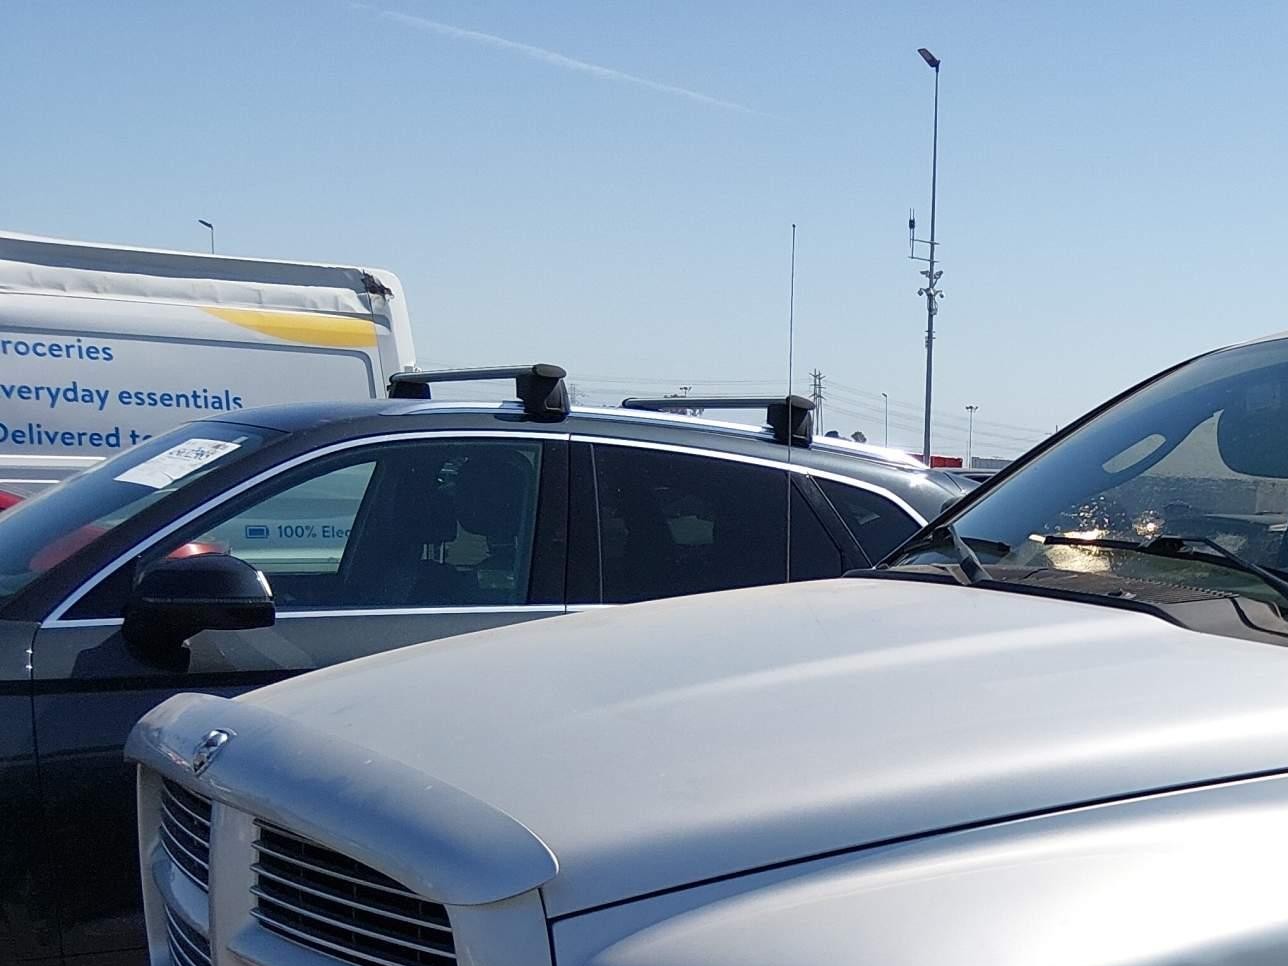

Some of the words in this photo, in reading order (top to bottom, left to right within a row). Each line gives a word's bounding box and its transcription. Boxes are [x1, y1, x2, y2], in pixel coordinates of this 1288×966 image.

[118, 388, 243, 411] essentials
[0, 422, 120, 448] Delivered
[278, 525, 317, 538] 100%
